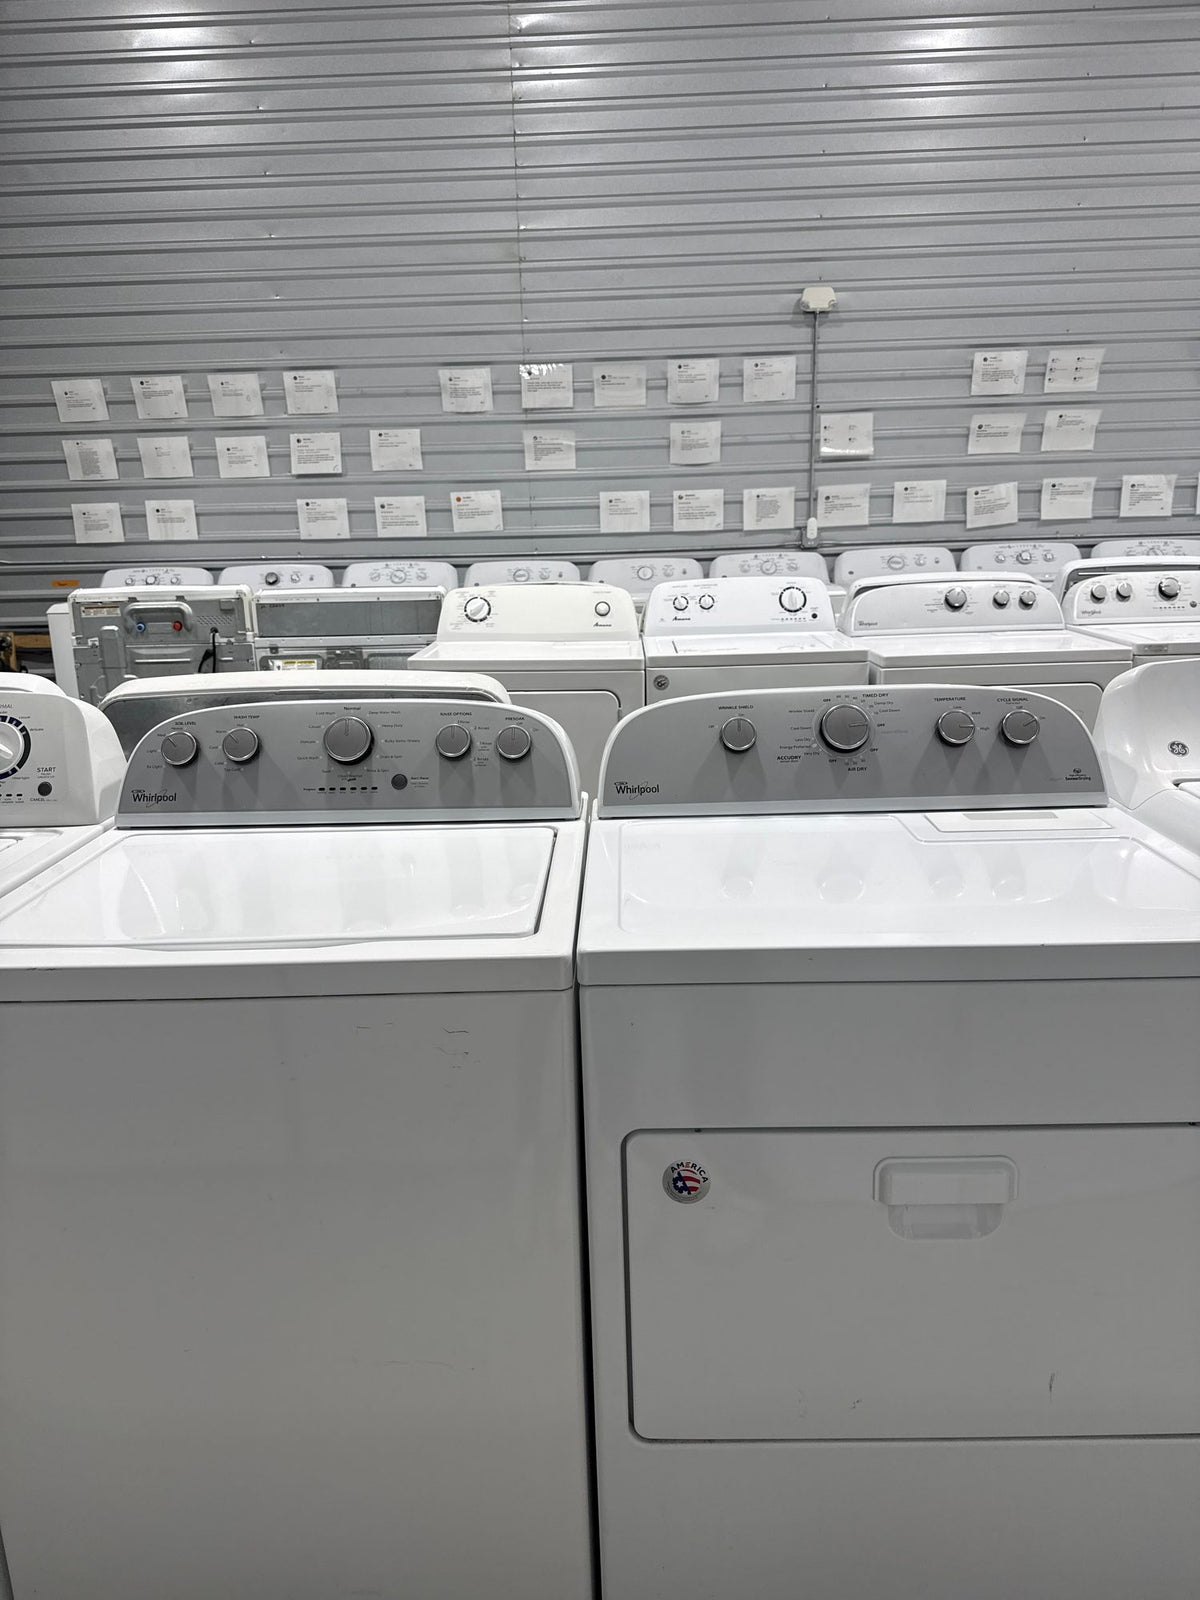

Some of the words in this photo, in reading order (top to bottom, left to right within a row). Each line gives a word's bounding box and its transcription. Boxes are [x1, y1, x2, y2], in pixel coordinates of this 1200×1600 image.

[614, 783, 660, 796] Whirlpool
[132, 792, 177, 805] Whirlpool
[670, 1161, 709, 1183] AMERICA
